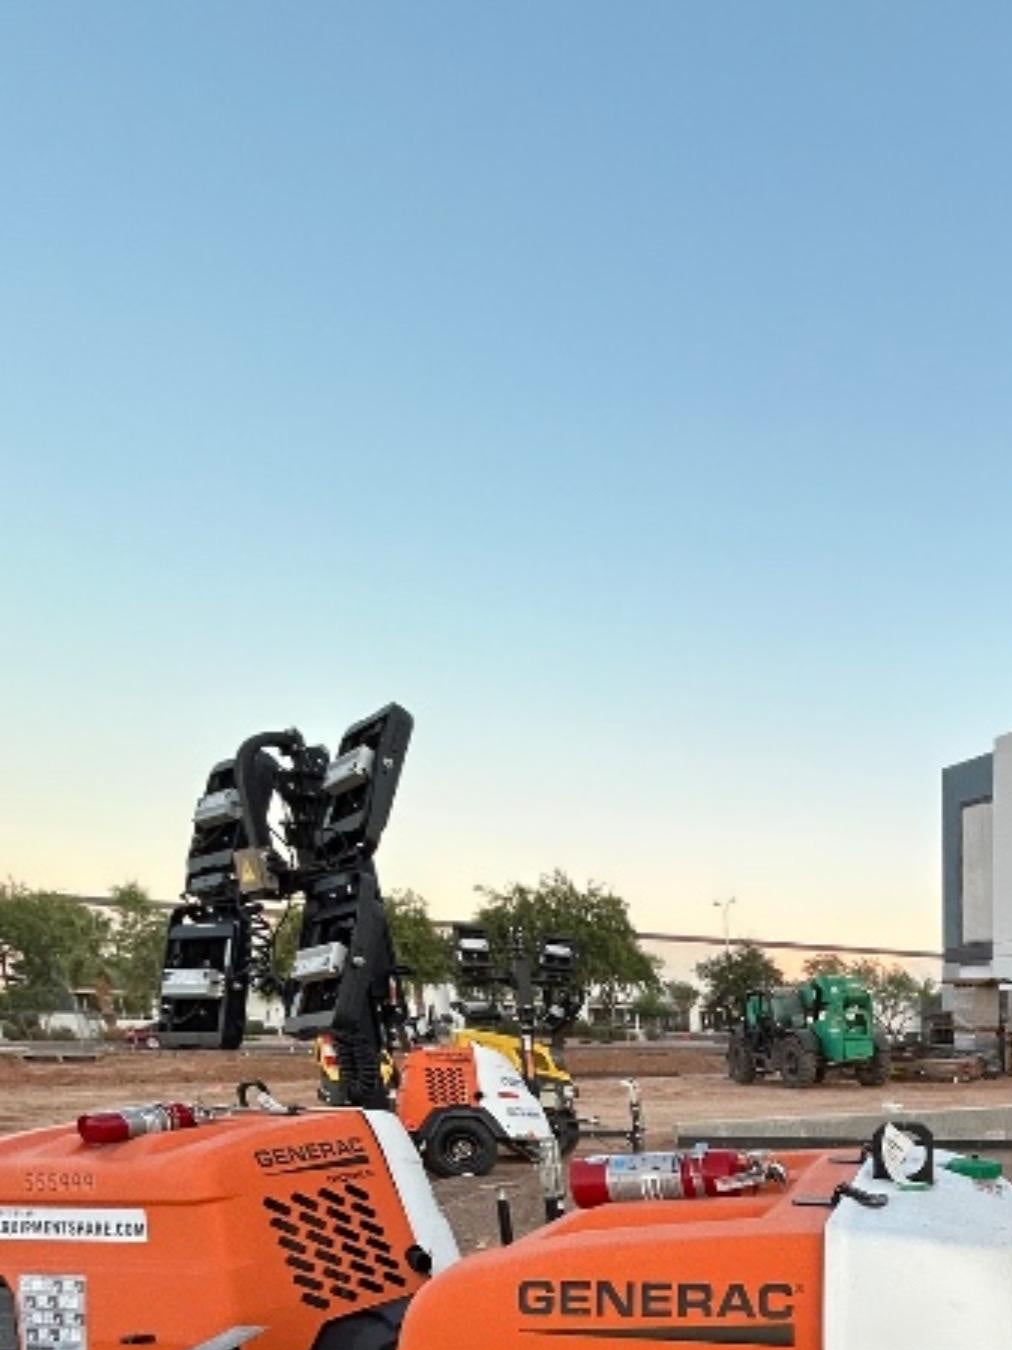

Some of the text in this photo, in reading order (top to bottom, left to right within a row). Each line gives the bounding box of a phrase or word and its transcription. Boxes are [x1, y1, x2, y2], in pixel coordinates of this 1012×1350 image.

[254, 1137, 366, 1168] GENERAC
[24, 1172, 95, 1192] 555999
[518, 1281, 796, 1320] GENERAC
